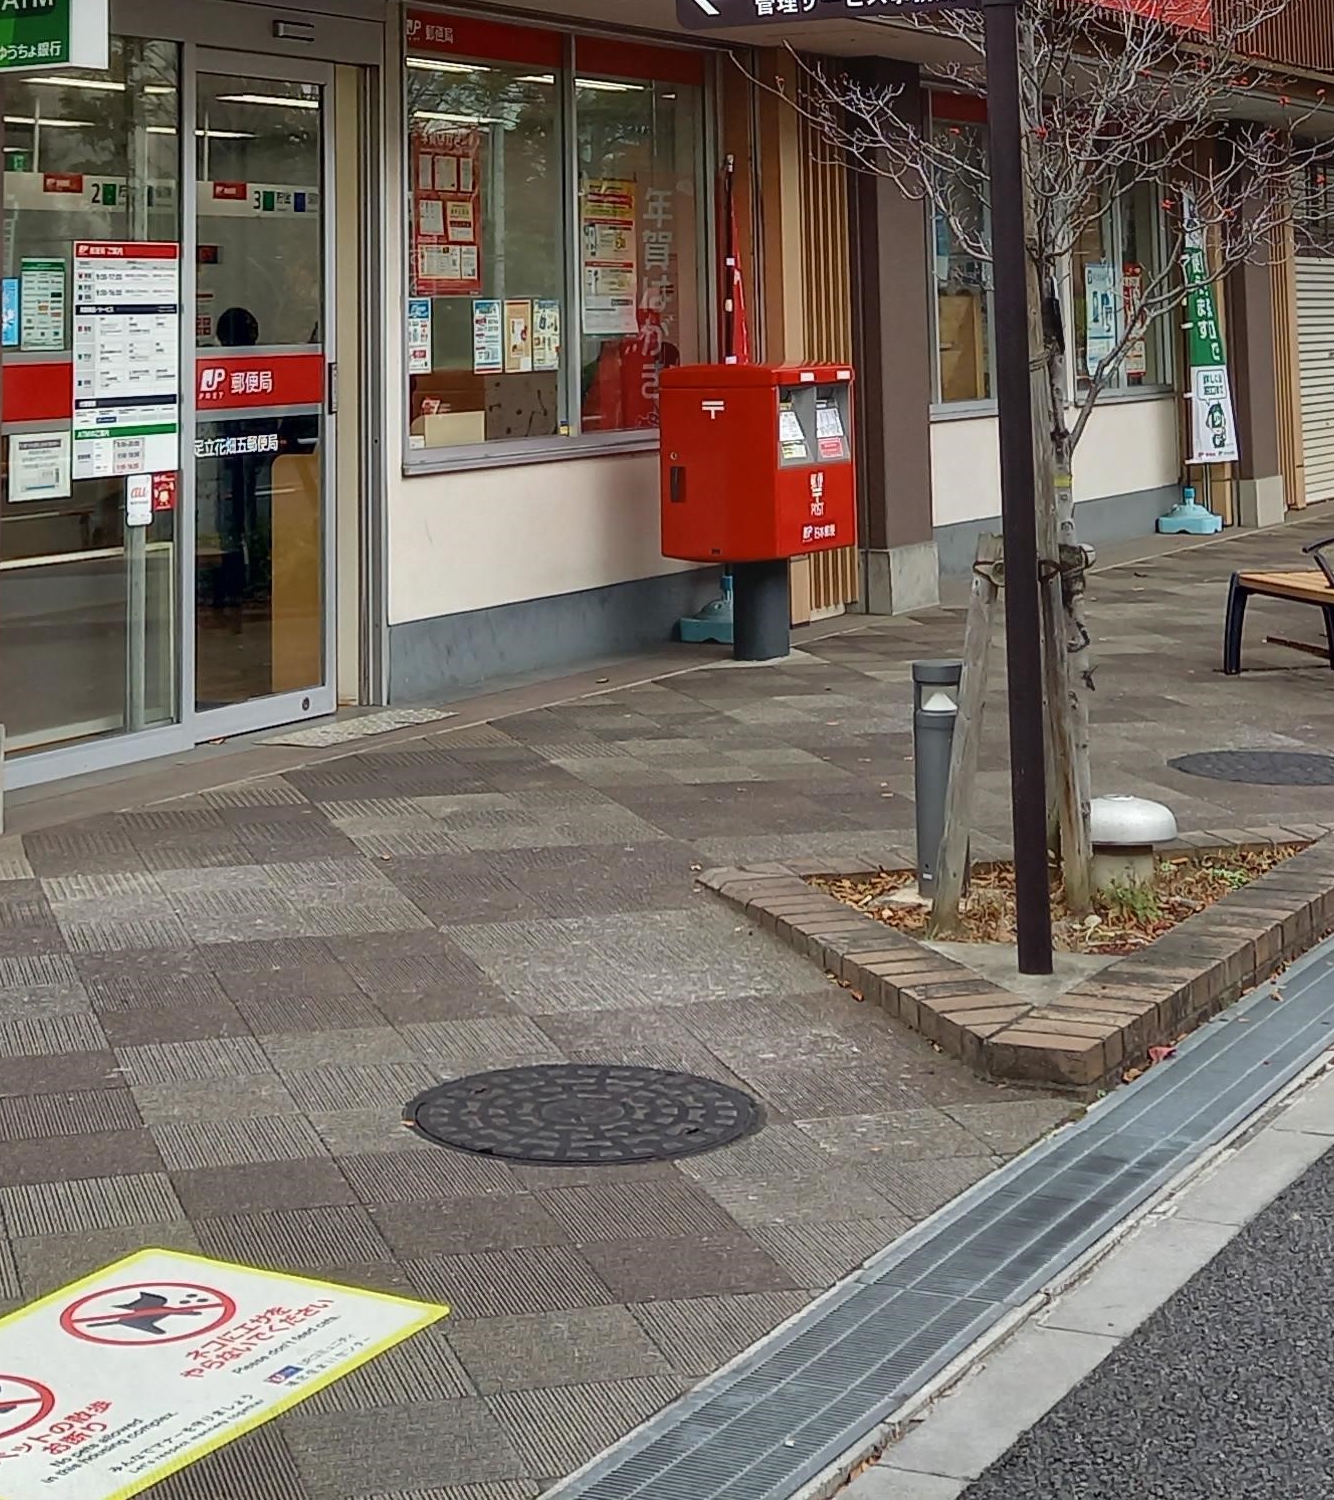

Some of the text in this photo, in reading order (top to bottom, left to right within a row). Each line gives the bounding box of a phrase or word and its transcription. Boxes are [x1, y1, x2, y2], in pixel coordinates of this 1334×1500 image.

[425, 24, 454, 44] 郵便局
[230, 371, 273, 394] 郵便局
[180, 1300, 334, 1377] やらないでください
[186, 1307, 292, 1360] ネコにエサを
[232, 1356, 269, 1374] Please
[43, 1422, 107, 1455] お断り
[49, 1458, 72, 1467] No
